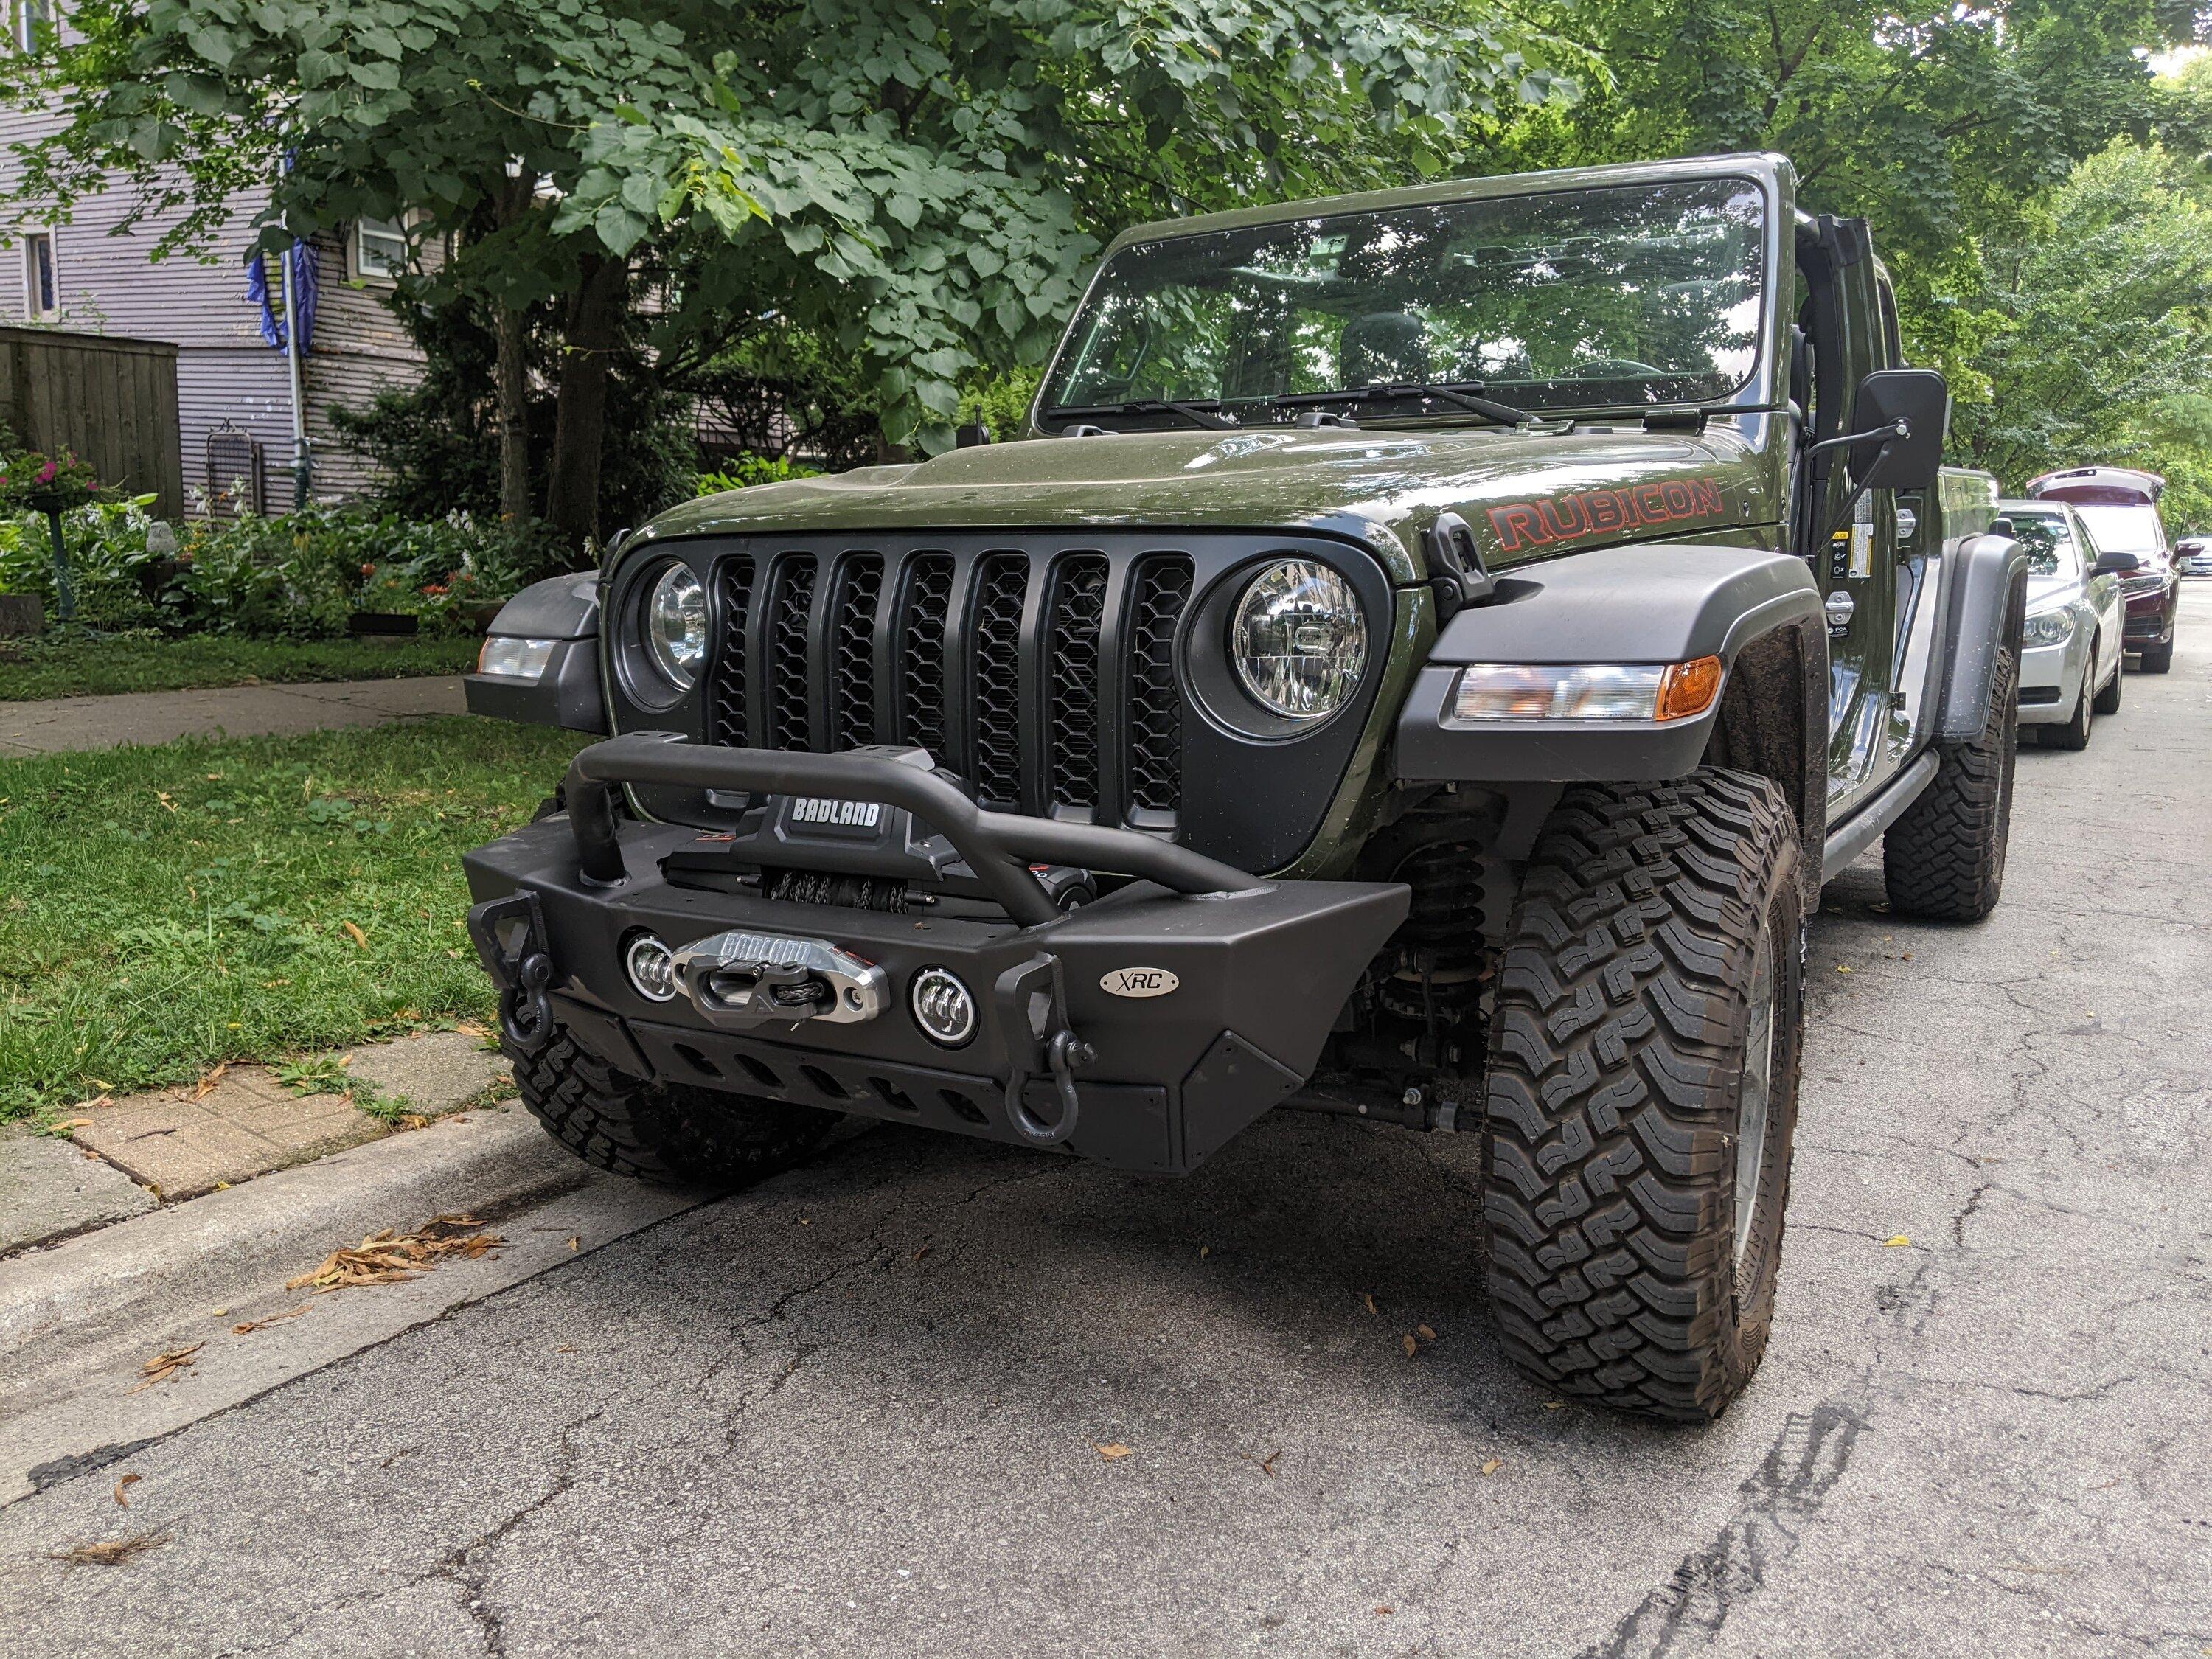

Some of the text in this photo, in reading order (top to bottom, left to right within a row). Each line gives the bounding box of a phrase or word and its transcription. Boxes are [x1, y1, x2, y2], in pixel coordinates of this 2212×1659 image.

[1486, 478, 1724, 551] RUBICON
[792, 798, 880, 827] BADLAND
[720, 933, 812, 965] BADLAND
[1116, 972, 1163, 992] XRC
